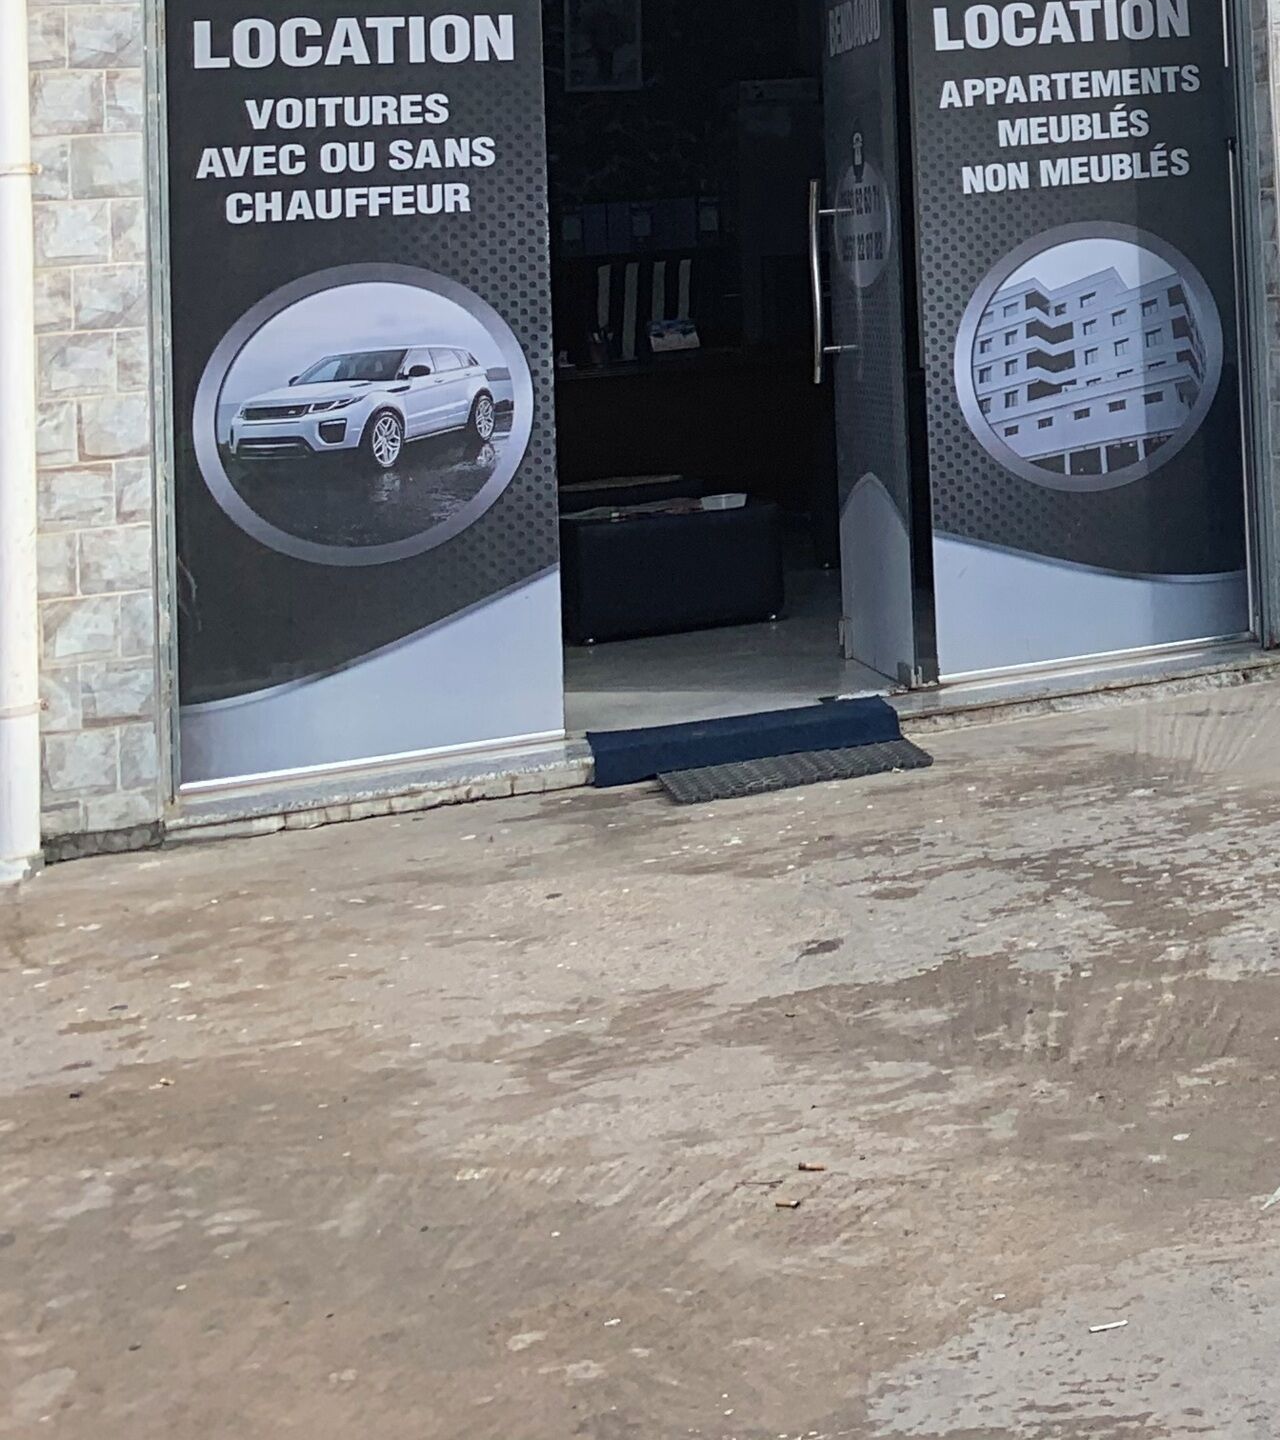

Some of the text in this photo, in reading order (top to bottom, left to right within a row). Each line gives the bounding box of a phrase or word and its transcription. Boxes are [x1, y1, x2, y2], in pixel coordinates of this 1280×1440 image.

[193, 14, 515, 69] LOCATION
[940, 64, 1201, 109] APPARTEMENTS
[245, 93, 449, 130] VOITURES
[998, 103, 1150, 148] MEUBLÉS
[196, 136, 497, 179] AVEC OU SANS
[962, 143, 1191, 195] NON MEUBLÉS
[226, 183, 471, 224] CHAUFFEUR
